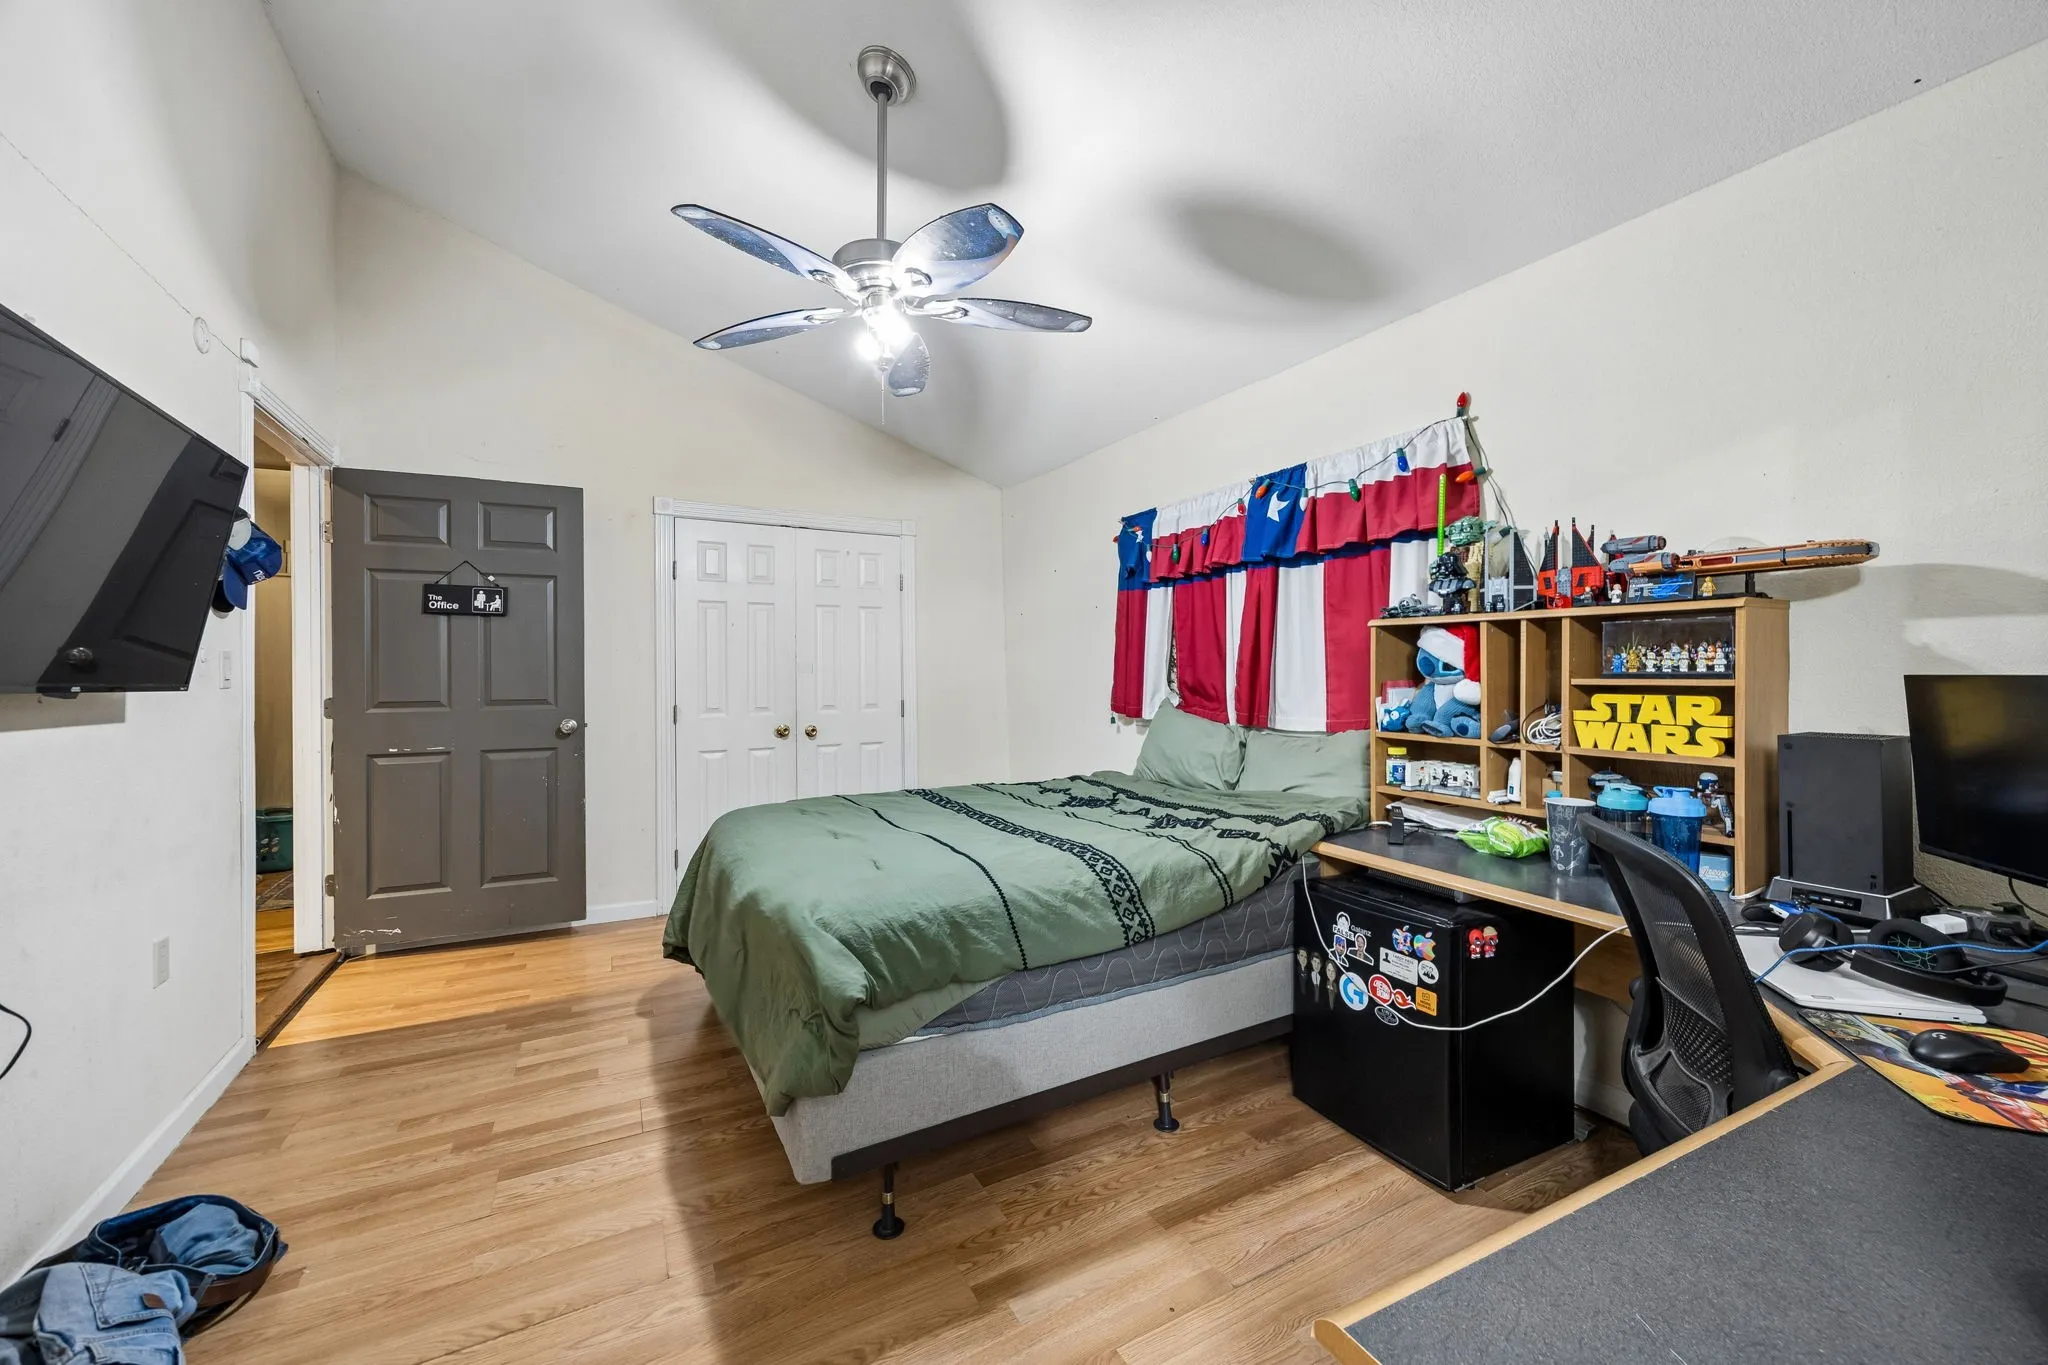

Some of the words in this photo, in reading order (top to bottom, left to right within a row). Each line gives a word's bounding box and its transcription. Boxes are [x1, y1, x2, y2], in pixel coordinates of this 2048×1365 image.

[428, 601, 459, 609] Office
[1573, 693, 1734, 728] STAR
[1573, 720, 1733, 758] WARS
